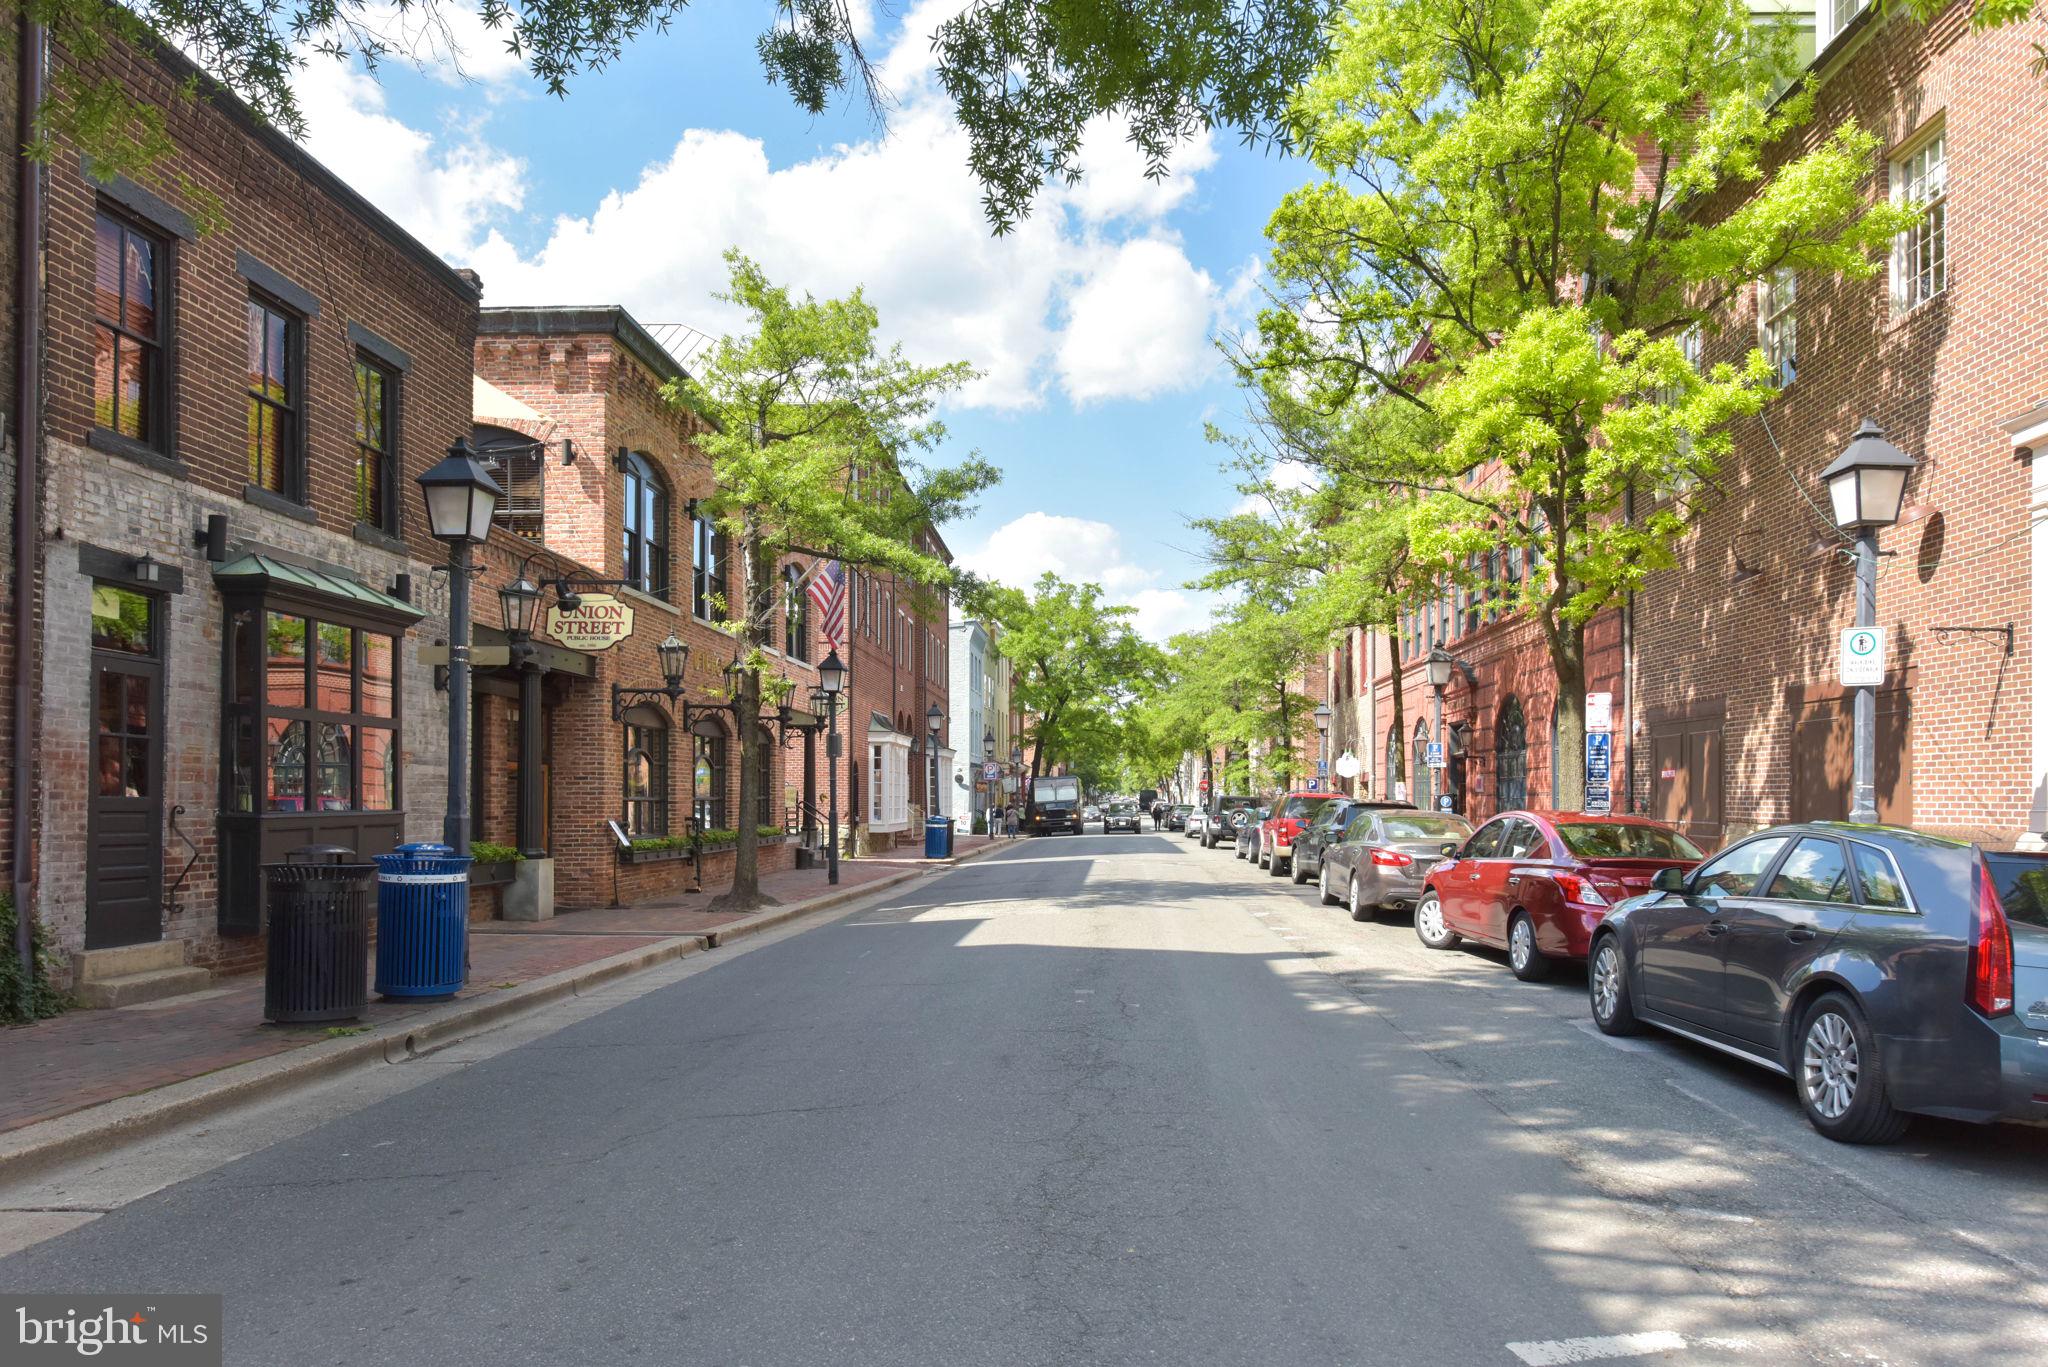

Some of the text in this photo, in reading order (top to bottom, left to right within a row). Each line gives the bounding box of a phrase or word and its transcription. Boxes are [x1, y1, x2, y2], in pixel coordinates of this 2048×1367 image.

[560, 605, 623, 619] UNION
[554, 620, 625, 634] STREET
[1308, 781, 1316, 789] P
